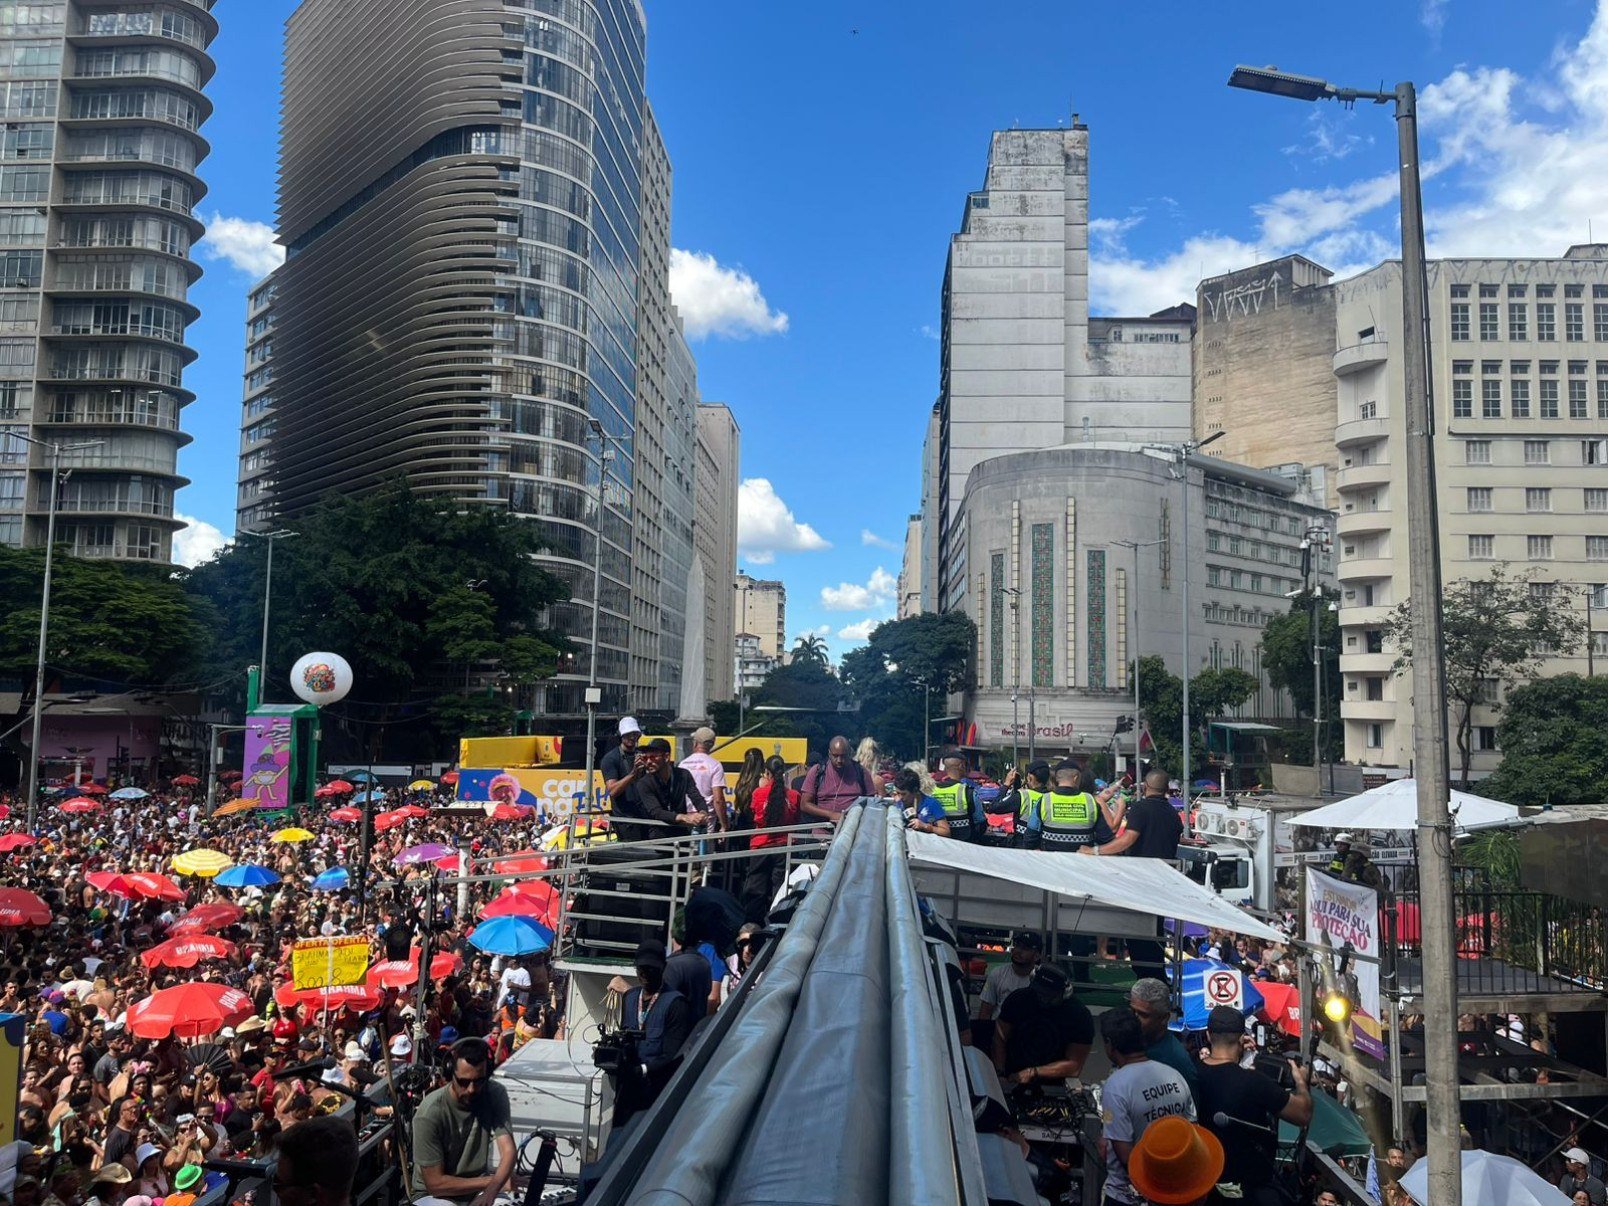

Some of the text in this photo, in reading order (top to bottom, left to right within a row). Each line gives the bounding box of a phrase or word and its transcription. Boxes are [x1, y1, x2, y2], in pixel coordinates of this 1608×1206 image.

[1328, 902, 1351, 923] PARA
[1350, 913, 1371, 939] SUA
[175, 943, 216, 955] BRAHMA
[331, 936, 367, 947] OFERTA
[1142, 1082, 1180, 1101] EQUIPE
